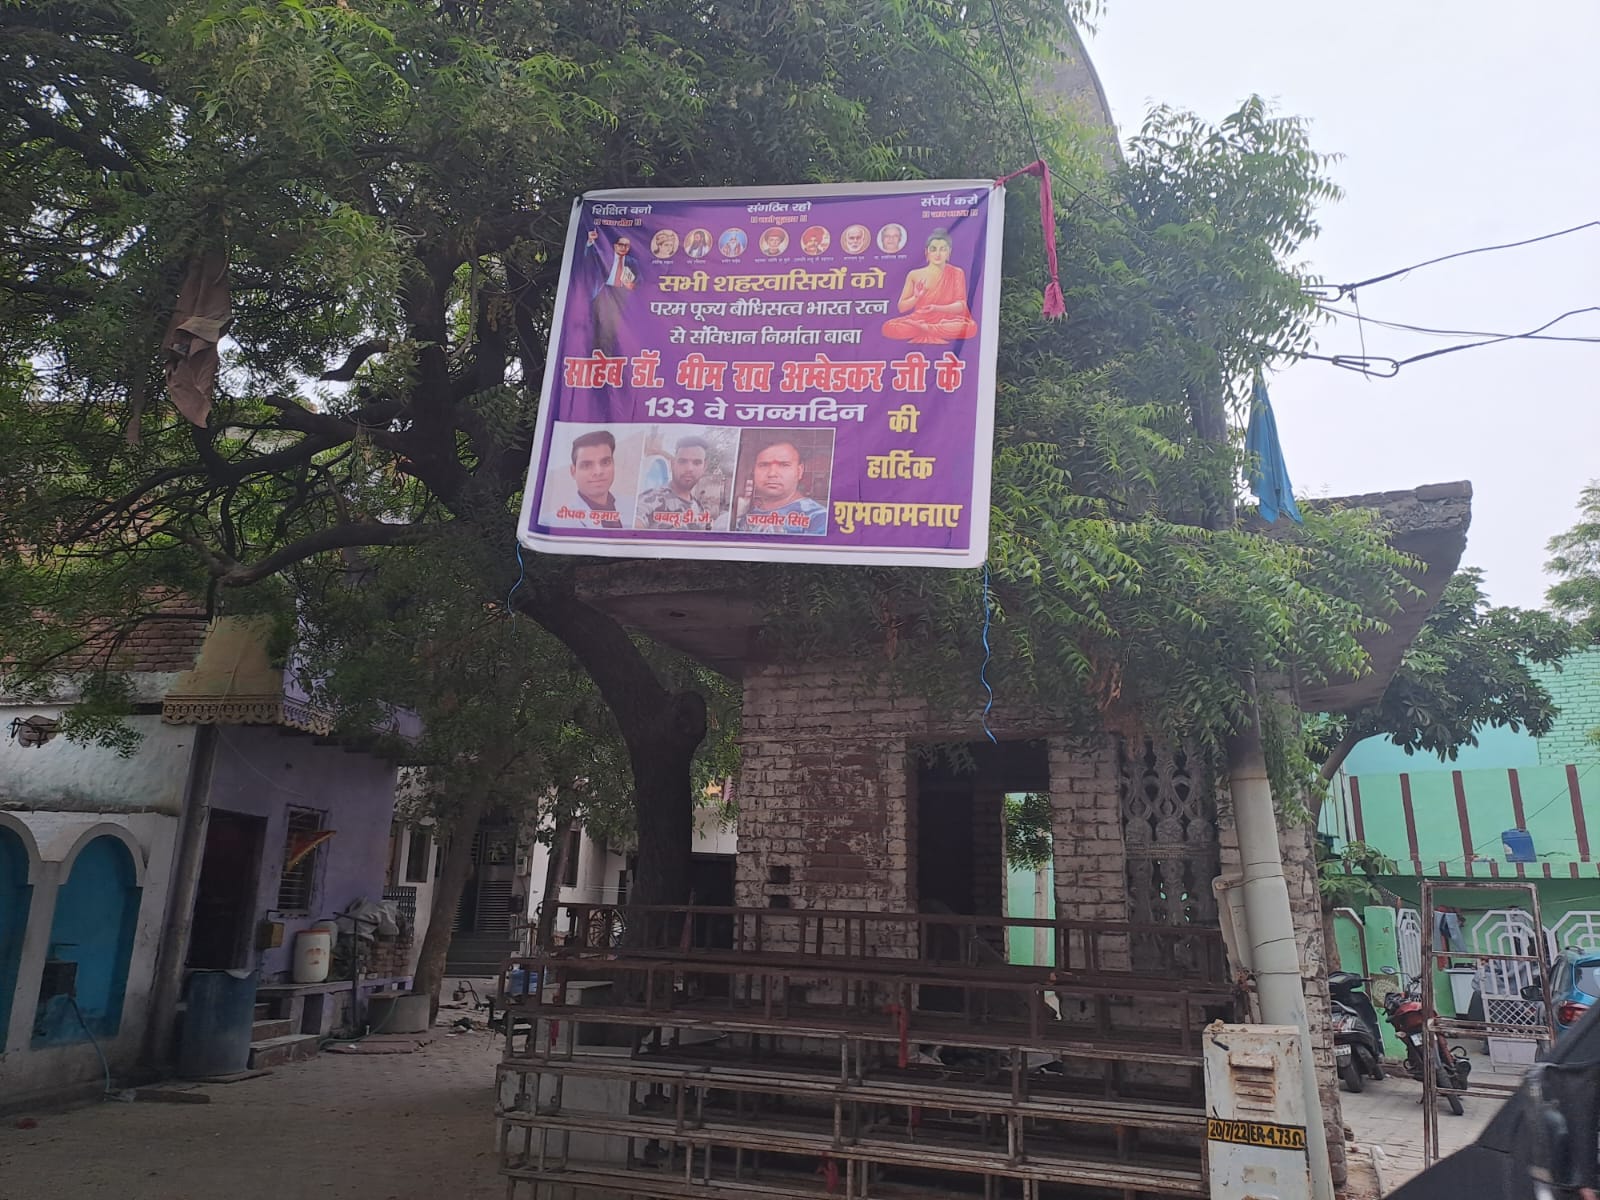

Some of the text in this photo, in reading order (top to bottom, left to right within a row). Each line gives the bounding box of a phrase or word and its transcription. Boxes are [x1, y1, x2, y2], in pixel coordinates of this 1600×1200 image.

[592, 203, 653, 215] शिक्षित बनो
[747, 201, 812, 213] संगठित रहो
[921, 194, 978, 207] संघर्ष करो
[658, 267, 887, 293] सभी शहरवासियों को
[650, 298, 890, 321] परम पूज्य बौधिसत्व भारत रत्न
[670, 325, 863, 345] से संविधान निर्माता बाबा
[564, 350, 966, 393] साहेब डॉ. भीम राव अम्बेडकर जी के
[645, 397, 868, 423] 133 वे जन्मदिन
[888, 404, 921, 432] की
[866, 450, 937, 479] हार्दिक
[556, 505, 621, 526] दीपक कुमार
[653, 511, 681, 529] बबलू
[746, 511, 811, 529] जयवीर सिंह
[833, 501, 963, 534] शुभकामनाए
